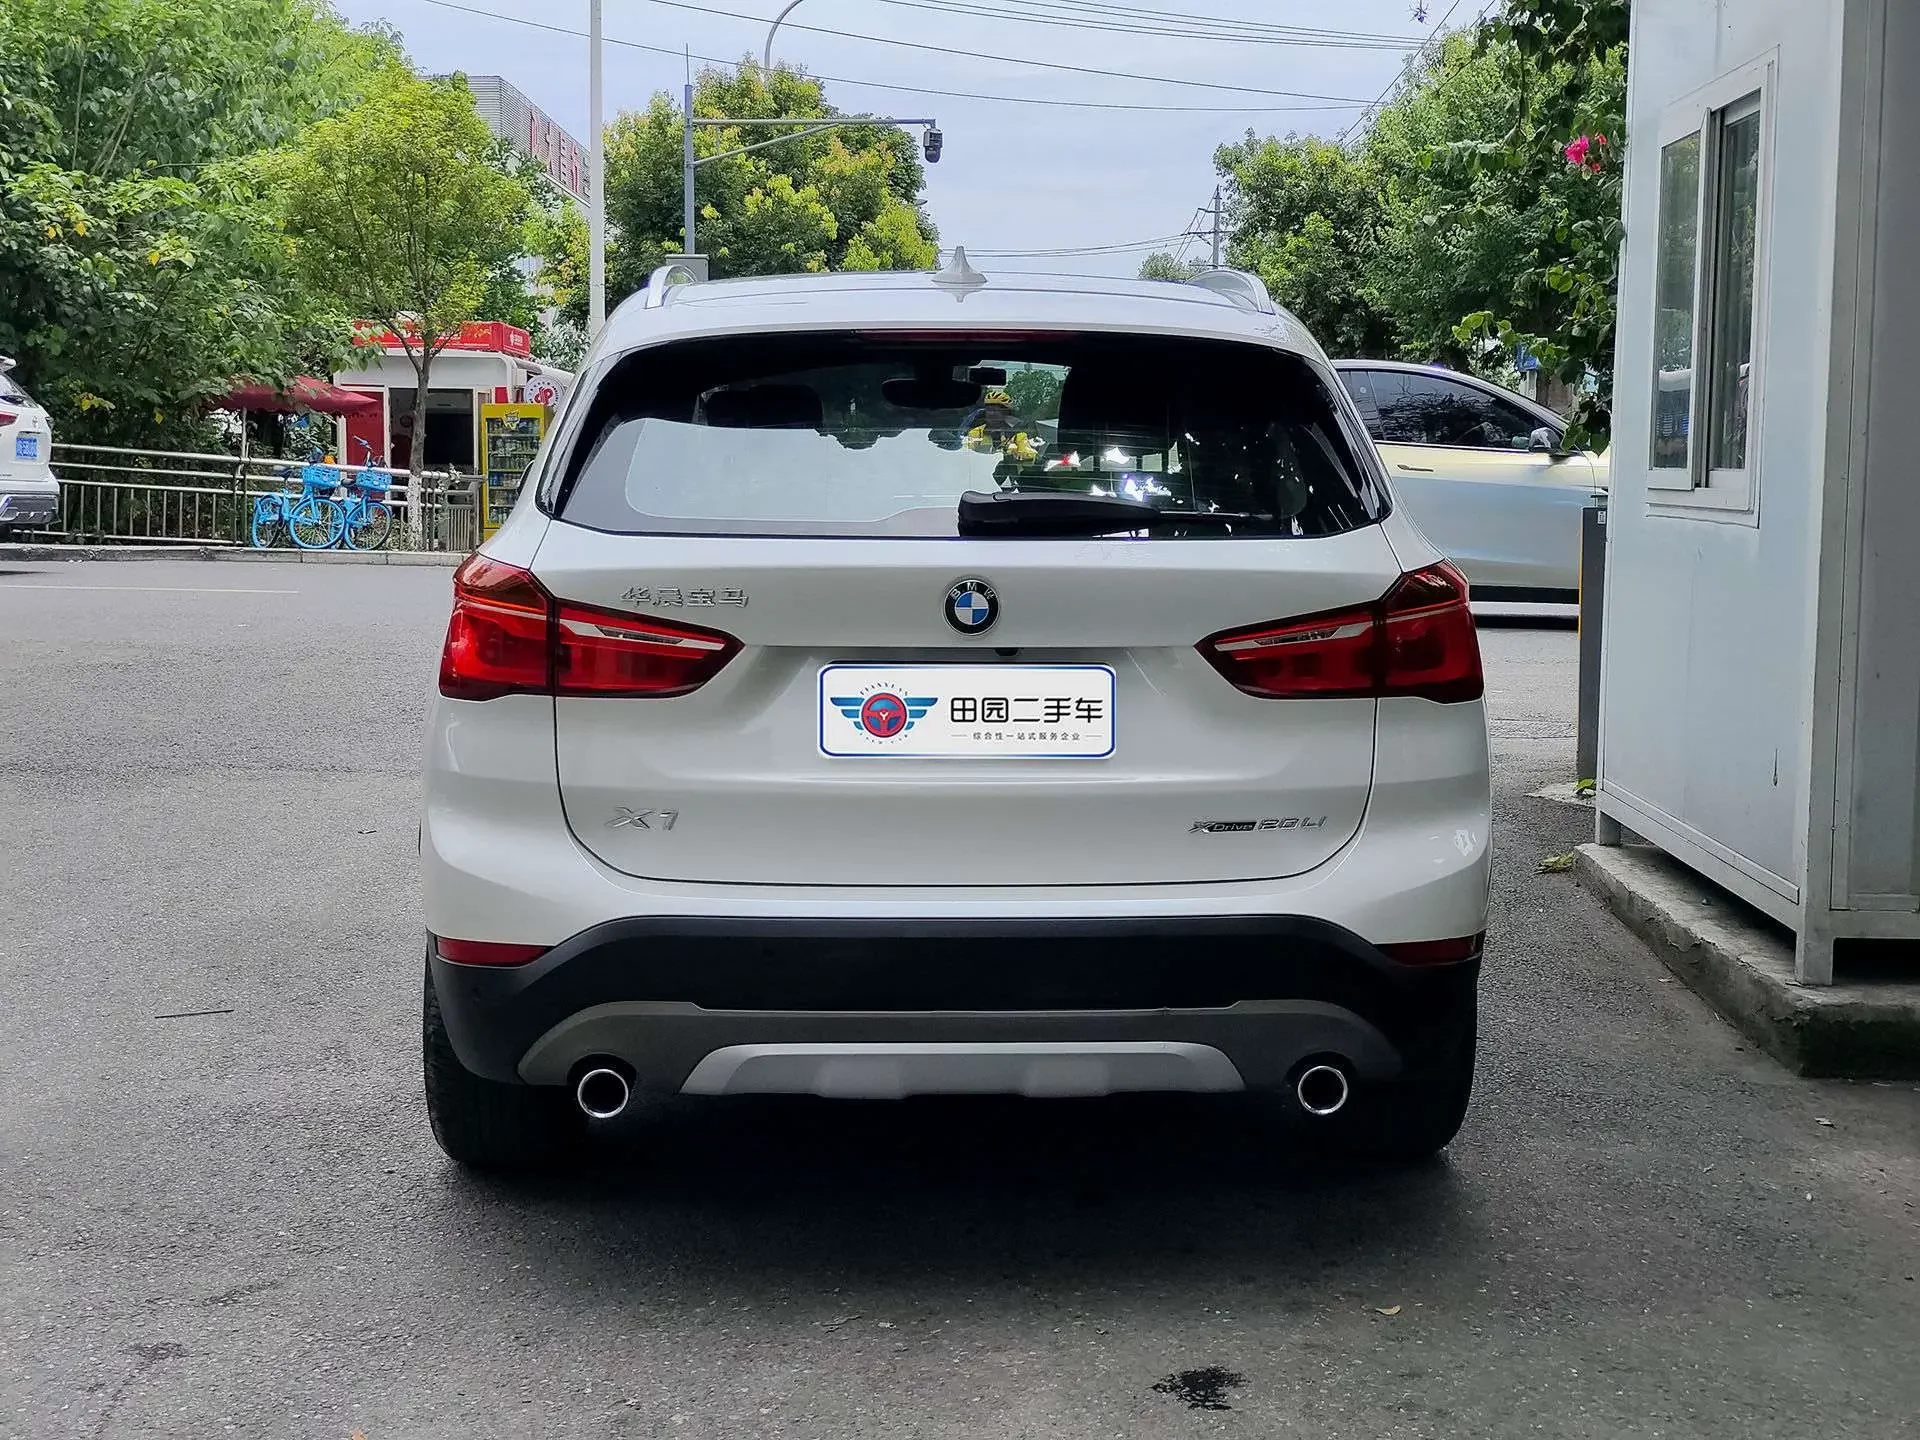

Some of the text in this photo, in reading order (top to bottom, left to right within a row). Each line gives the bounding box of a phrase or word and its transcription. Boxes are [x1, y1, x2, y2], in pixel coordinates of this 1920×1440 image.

[621, 586, 749, 607] 华晨宝马
[950, 582, 995, 600] BMW
[950, 697, 1103, 723] 田园二手车
[604, 806, 679, 831] X1
